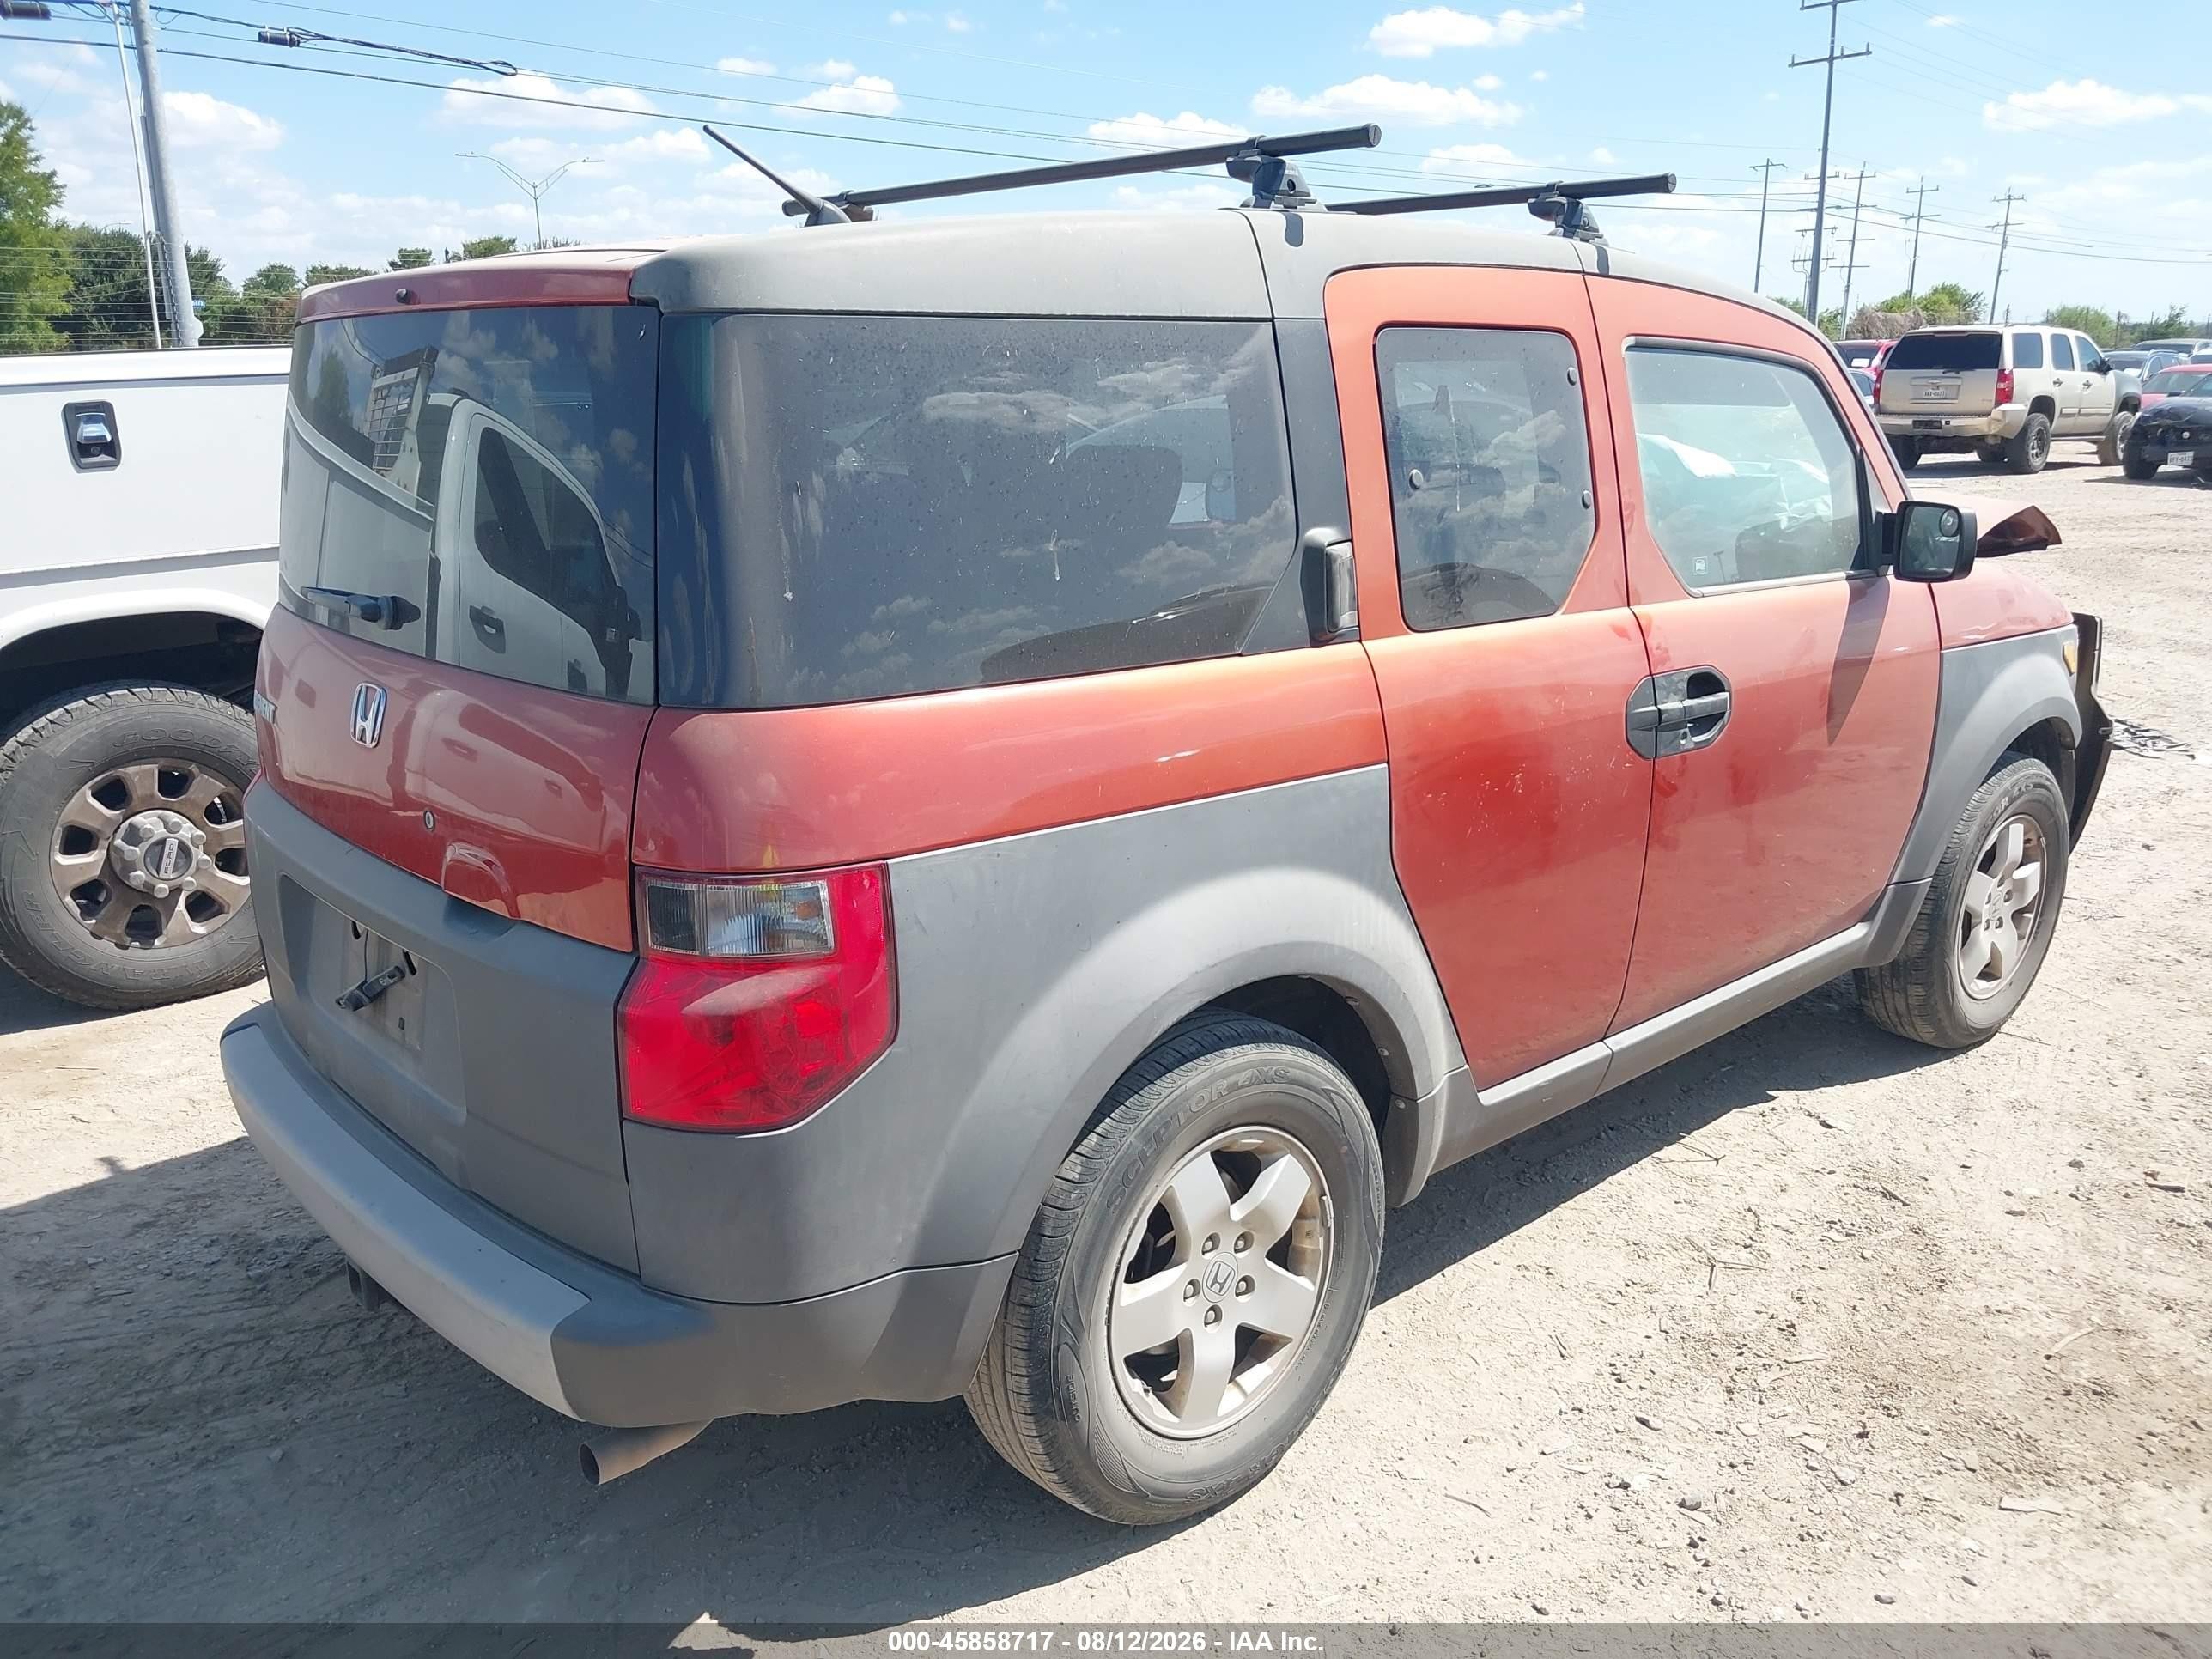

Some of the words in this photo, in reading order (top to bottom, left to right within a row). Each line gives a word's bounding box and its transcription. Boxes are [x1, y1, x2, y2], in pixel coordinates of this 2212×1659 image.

[163, 843, 174, 874] FORD
[1106, 1078, 1231, 1215] SCEPTOR
[1237, 1065, 1291, 1088] 4XS
